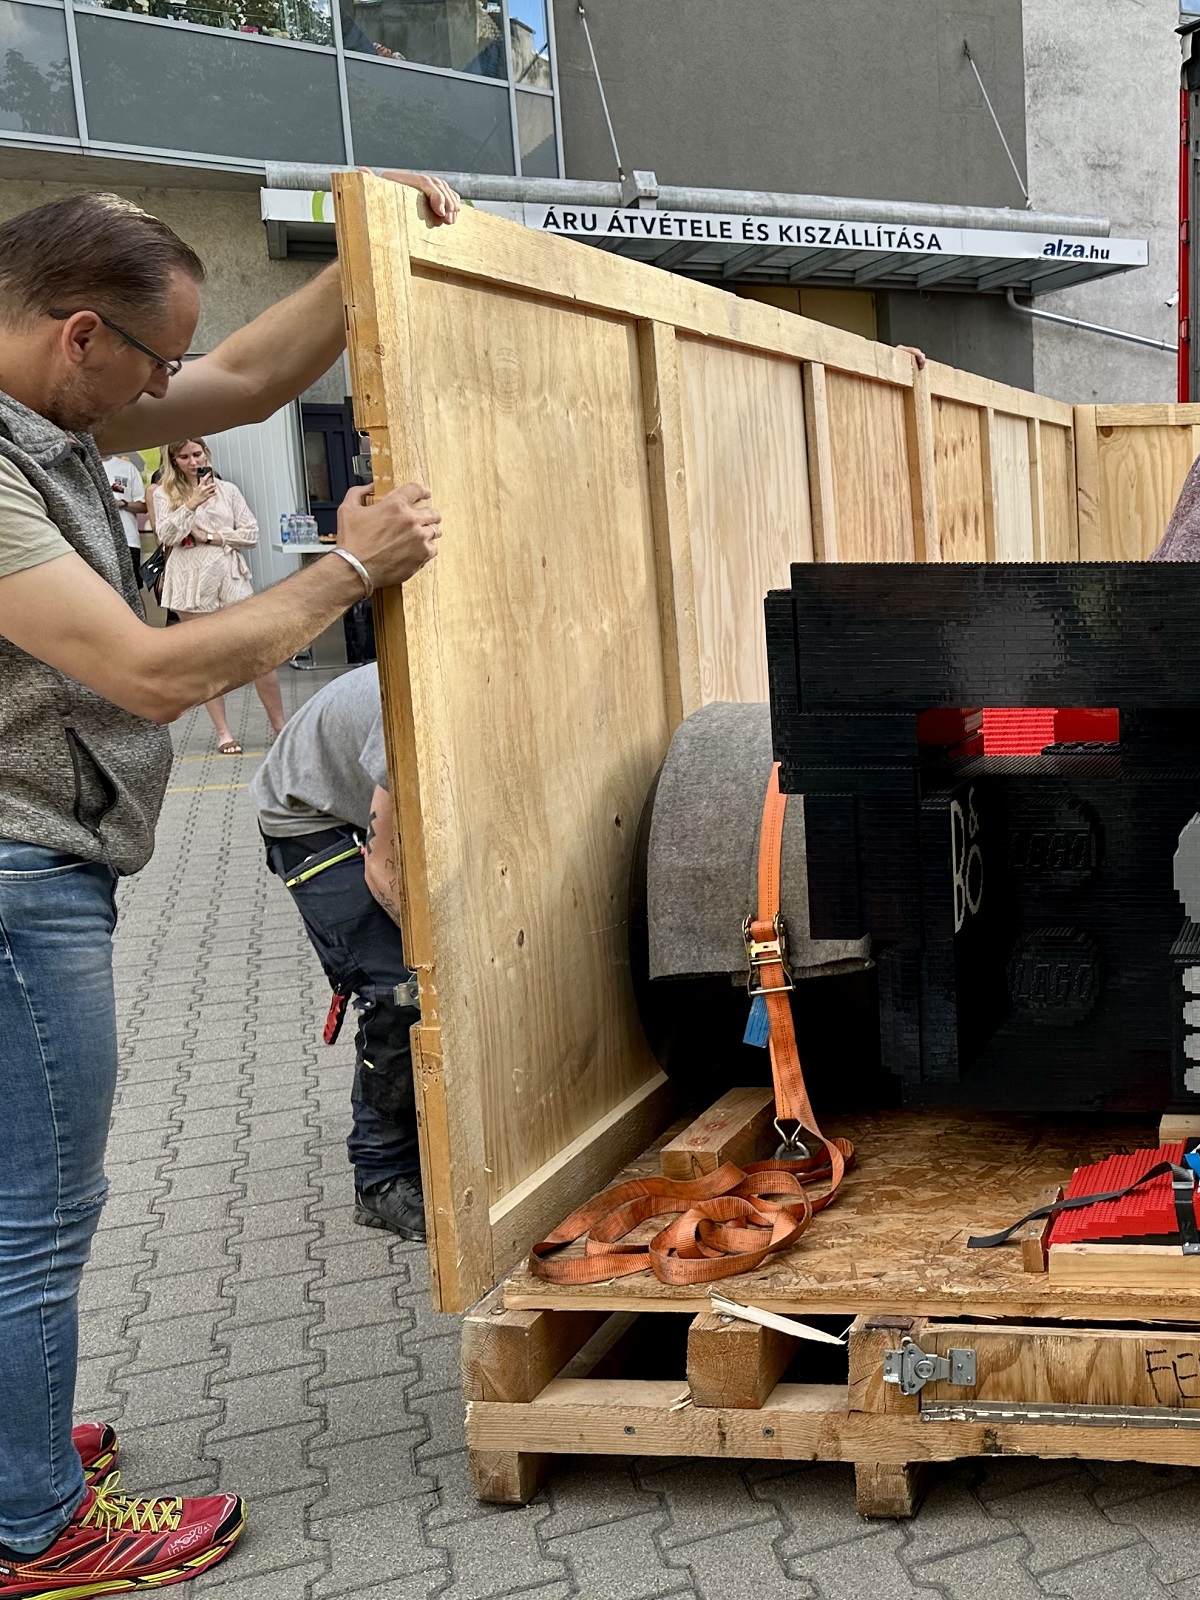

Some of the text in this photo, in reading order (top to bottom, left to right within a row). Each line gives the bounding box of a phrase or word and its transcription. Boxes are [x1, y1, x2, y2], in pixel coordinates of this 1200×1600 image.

[542, 210, 943, 251] ÁRU ÁTVÉTELE ÉS KISZÁLLÍTÁSA
[1043, 238, 1110, 260] alza.hu
[1011, 963, 1092, 1000] LEGO
